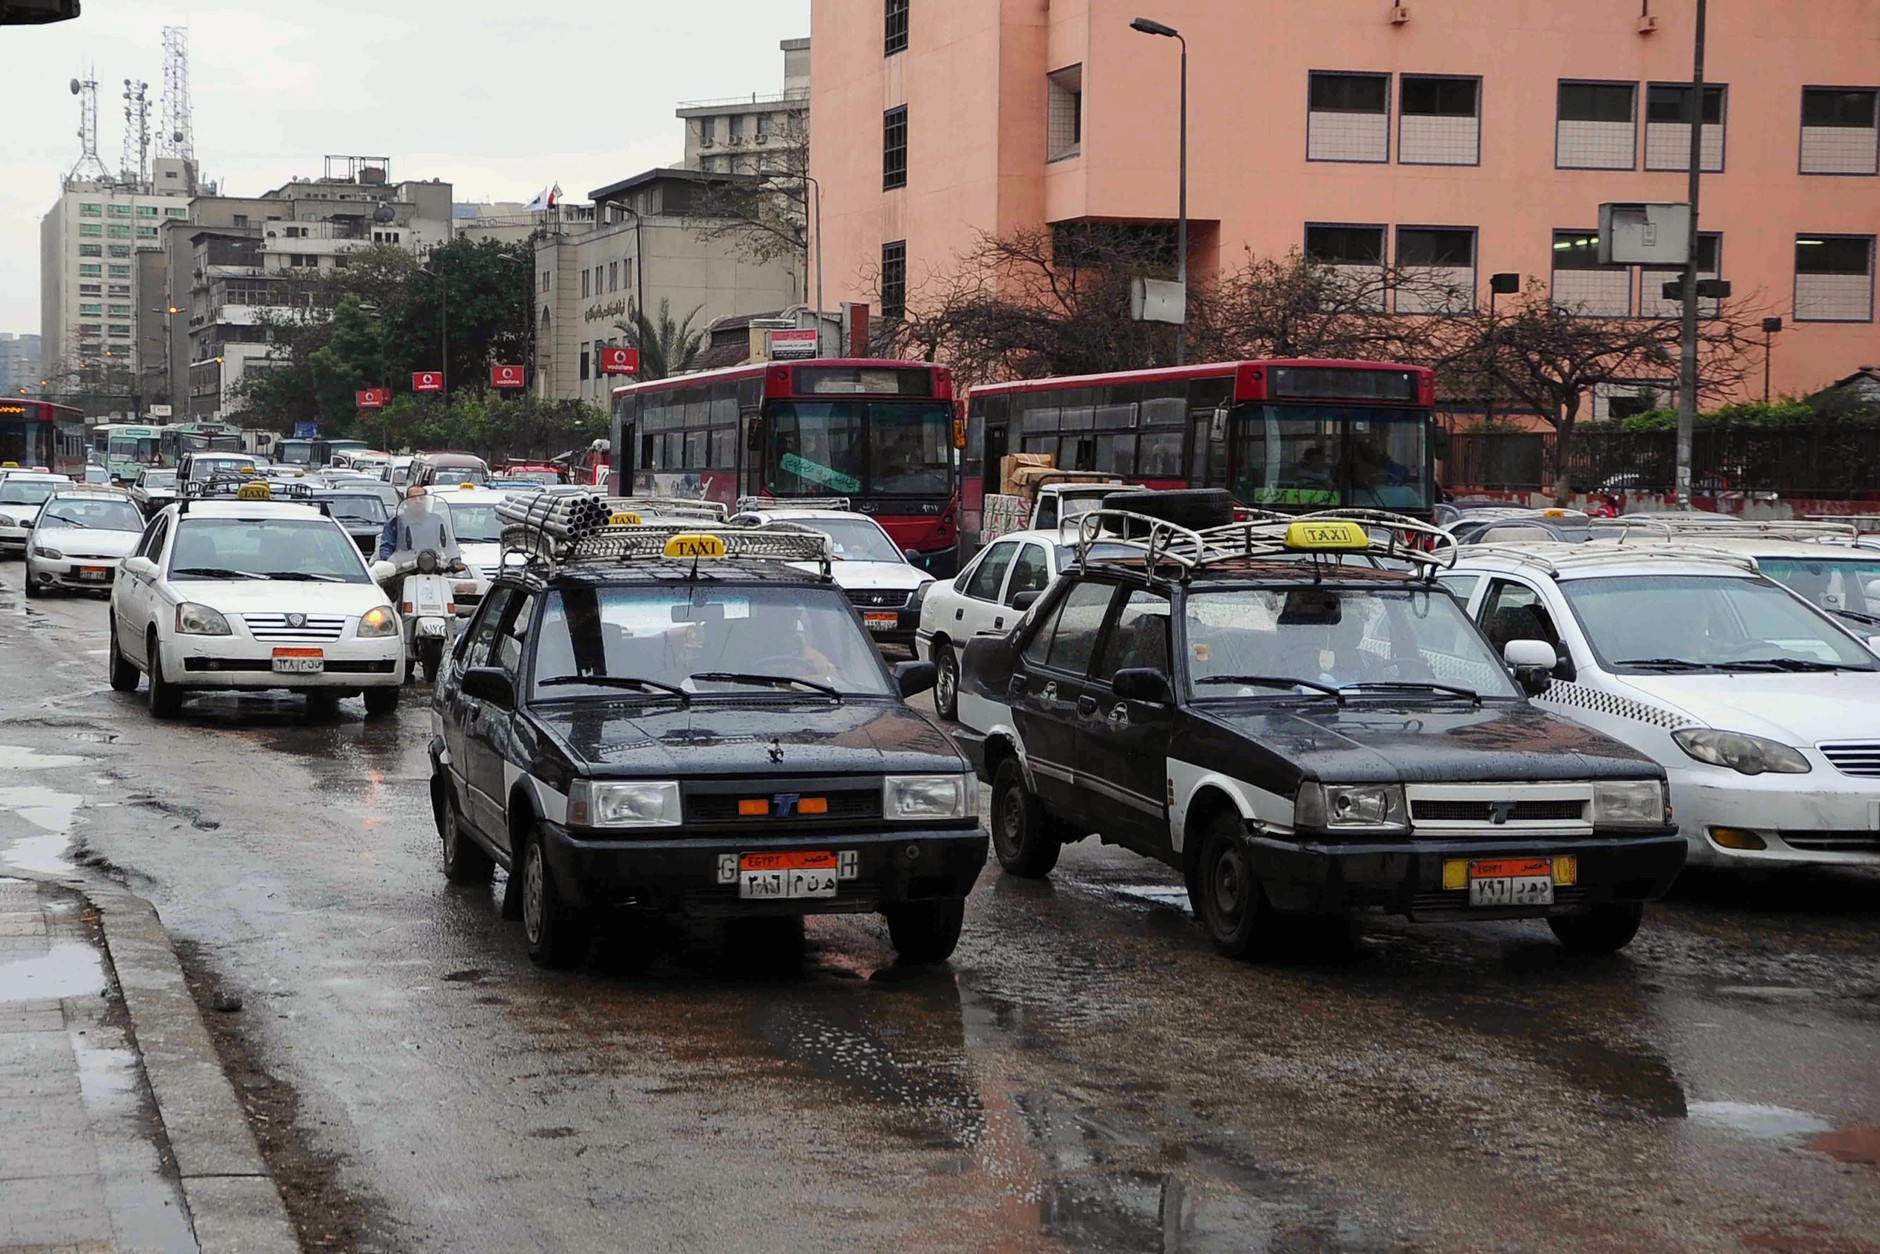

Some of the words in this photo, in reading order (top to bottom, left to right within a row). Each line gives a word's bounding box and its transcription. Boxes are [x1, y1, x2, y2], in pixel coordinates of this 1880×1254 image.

[244, 489, 267, 498] TAXI
[613, 516, 636, 524] TAXI
[1308, 529, 1348, 541] TAXI
[676, 541, 716, 555] TAXI
[747, 855, 781, 867] EGYPT
[802, 854, 829, 865] مصر
